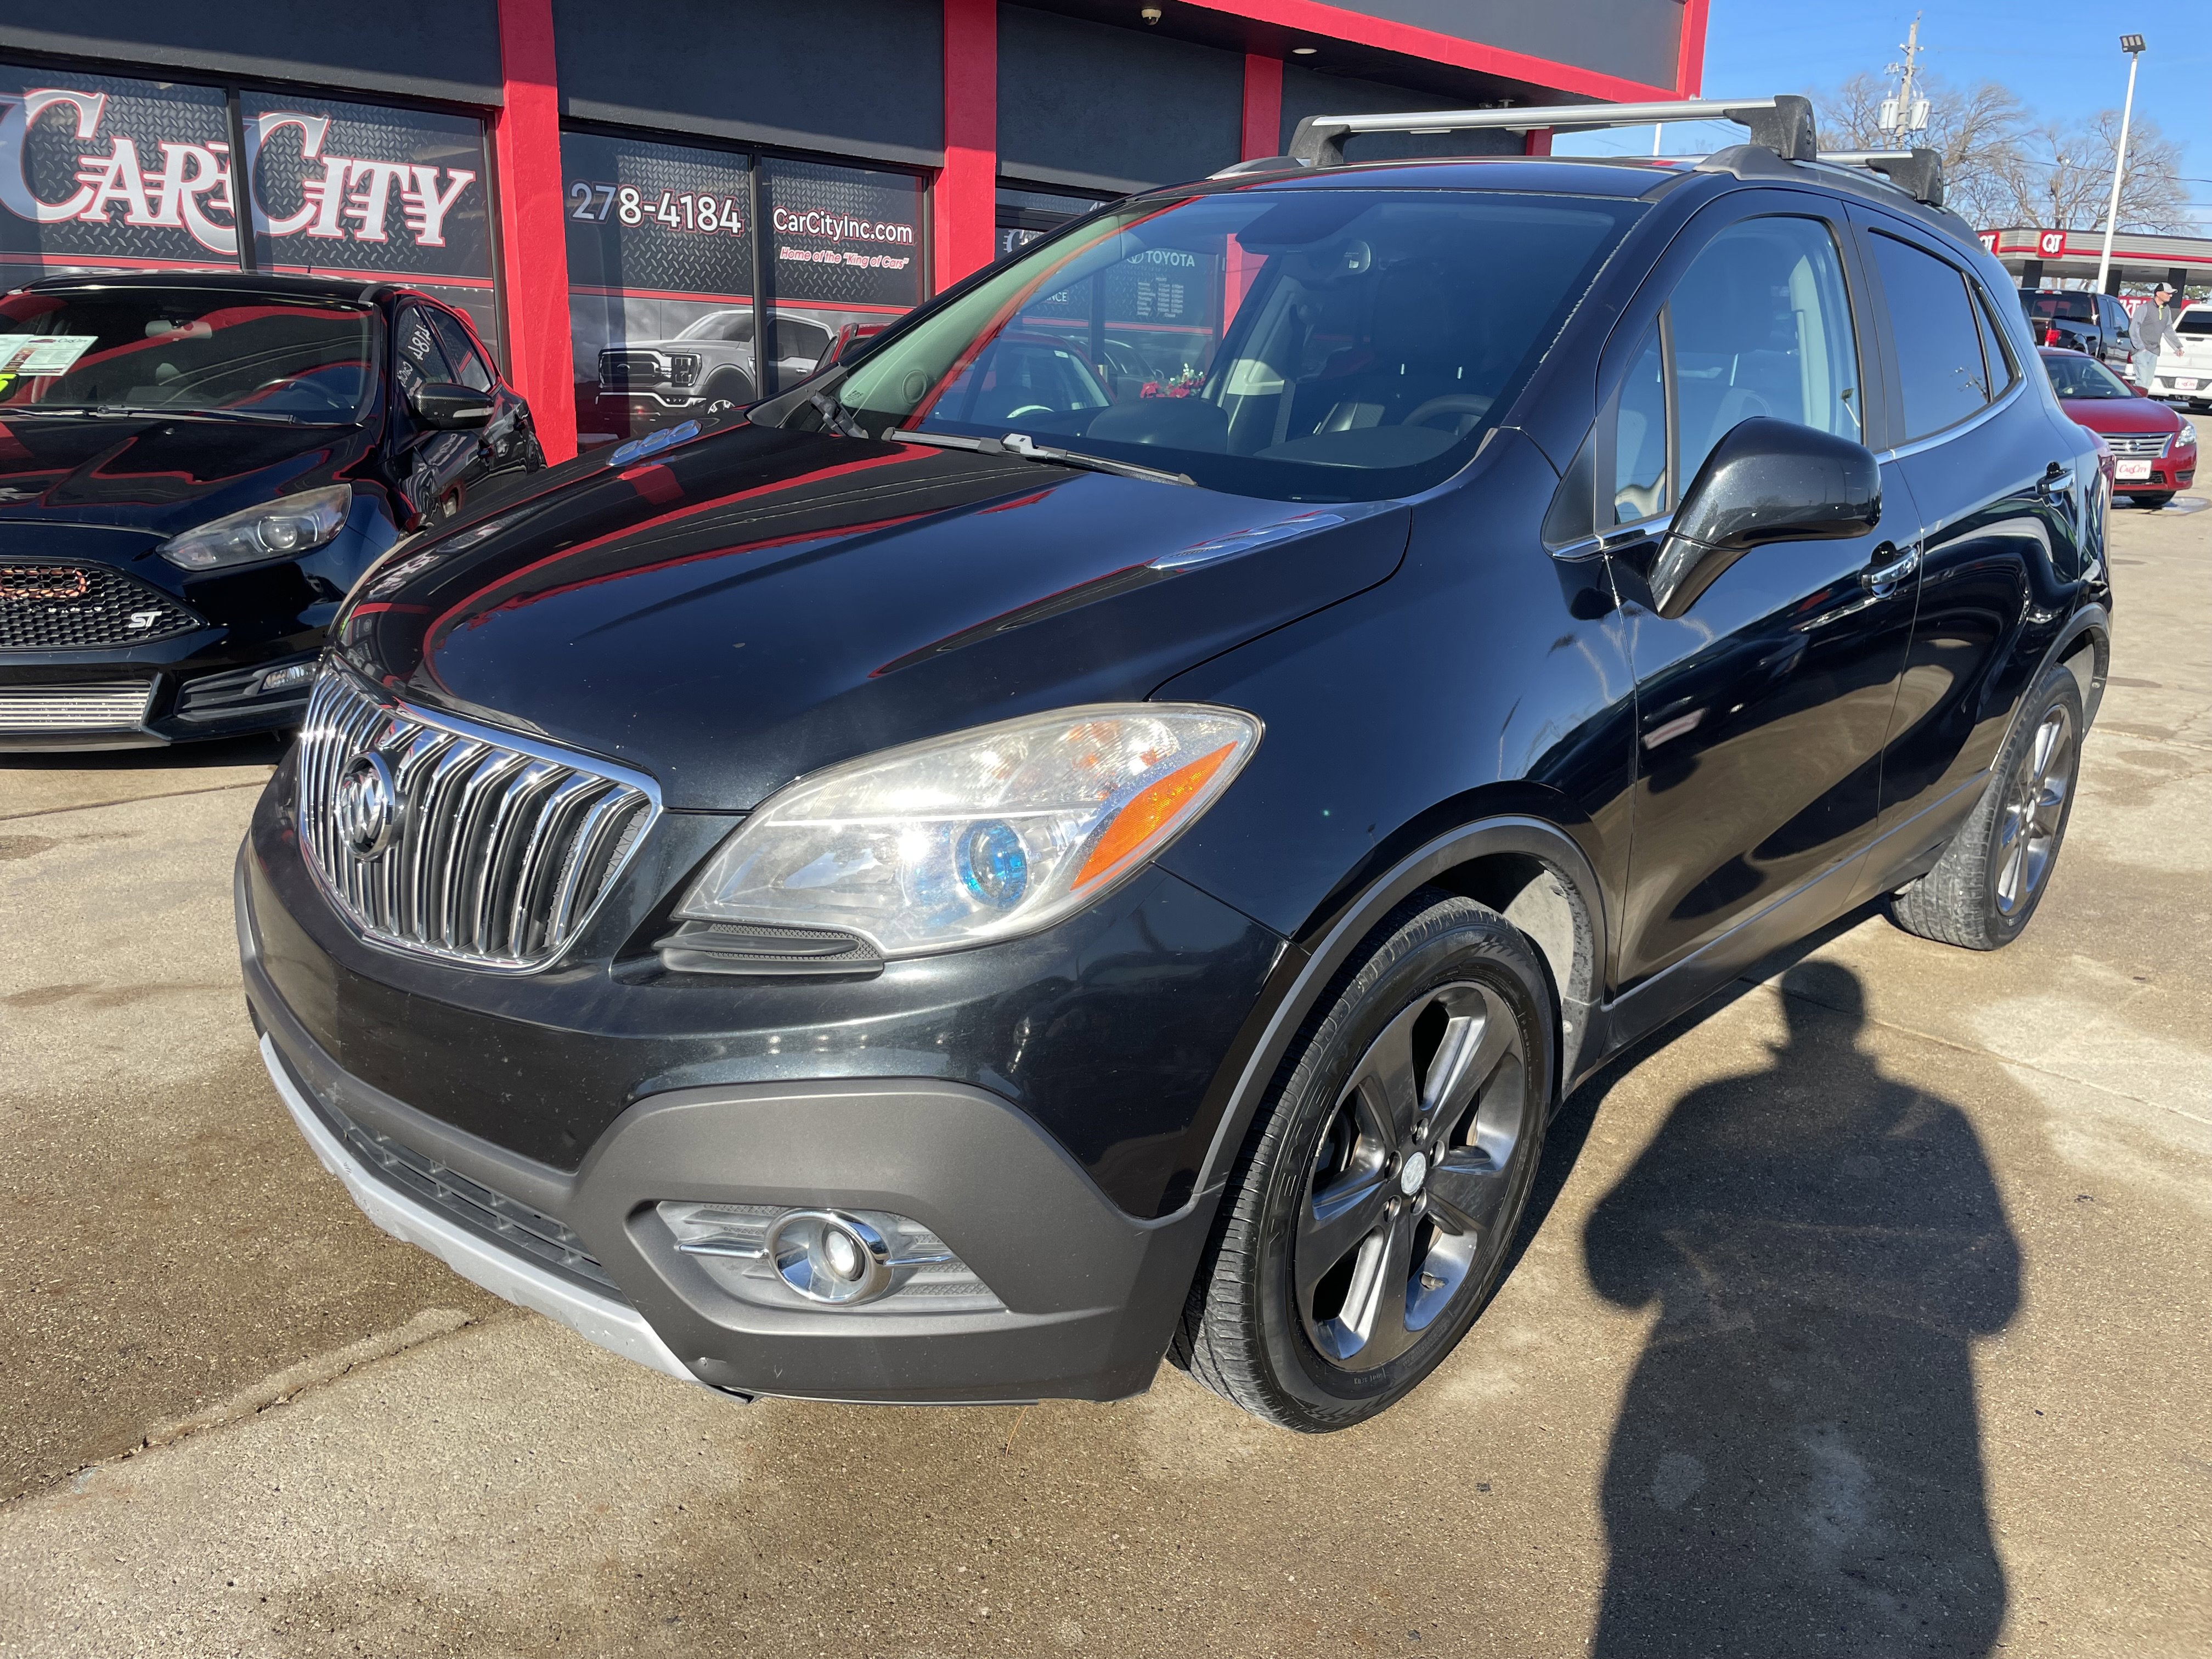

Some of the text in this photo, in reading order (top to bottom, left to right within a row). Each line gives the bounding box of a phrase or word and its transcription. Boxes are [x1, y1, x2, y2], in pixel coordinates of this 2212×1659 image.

[571, 183, 742, 233] 278-4184
[773, 208, 913, 243] CarCityInc.com
[2042, 234, 2063, 254] QT
[781, 246, 811, 260] Home
[812, 251, 825, 261] of
[825, 251, 842, 264] the
[870, 256, 882, 268] of
[1146, 250, 1195, 267] TOYOTA
[128, 611, 162, 628] ST
